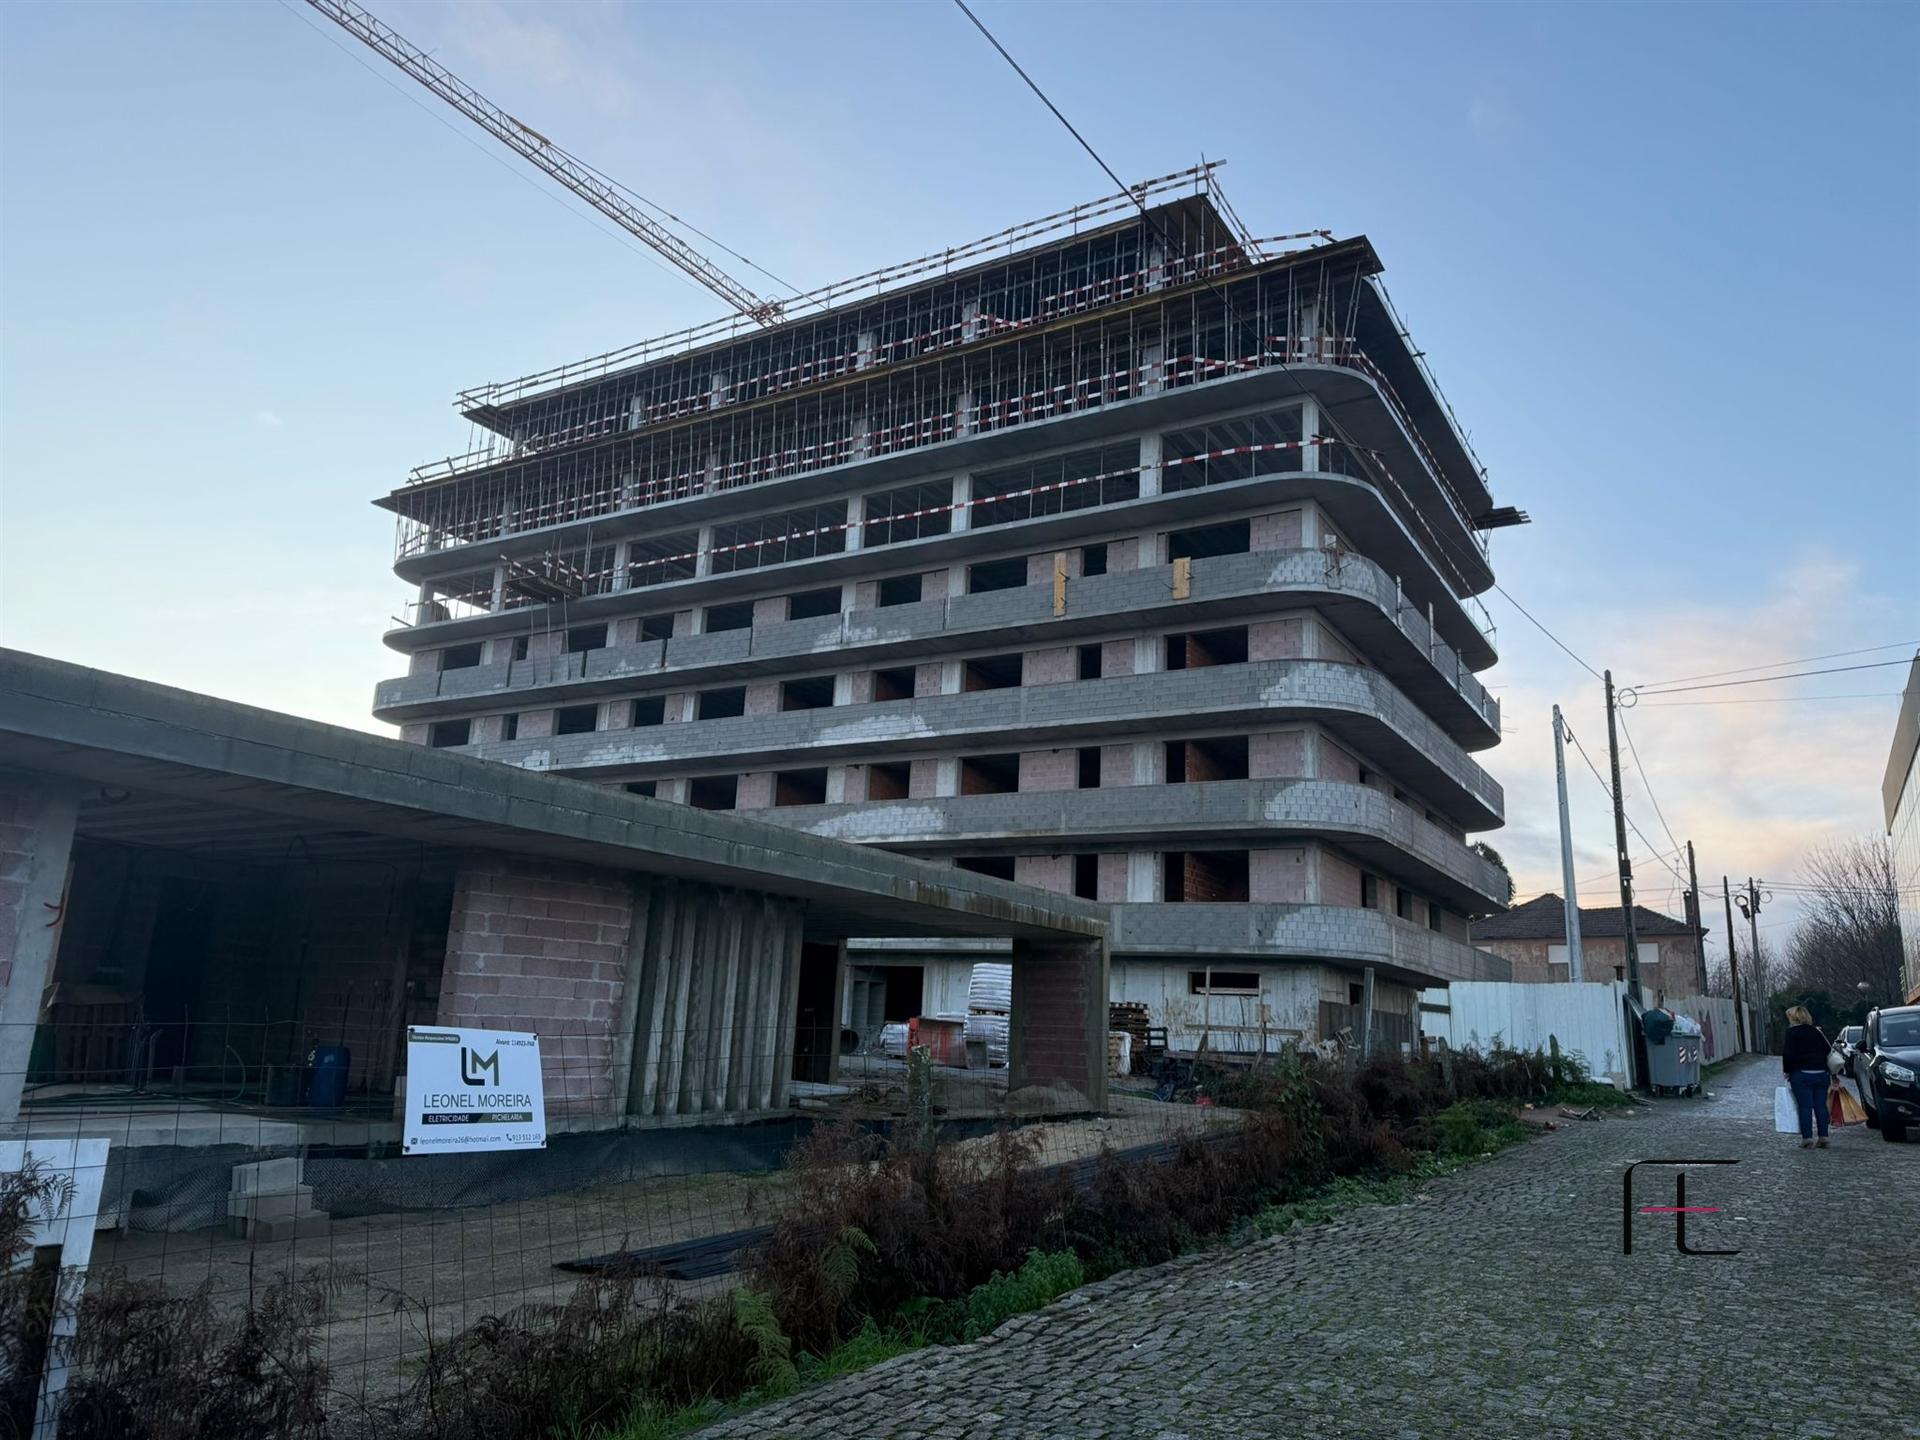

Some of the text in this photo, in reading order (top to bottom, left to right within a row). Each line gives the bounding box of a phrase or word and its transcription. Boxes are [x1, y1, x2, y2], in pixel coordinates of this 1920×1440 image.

[461, 1047, 499, 1086] LM
[423, 1093, 532, 1108] LEONEL MOREIRA
[428, 1113, 524, 1123] ELETRICIDADE PICHELARIA
